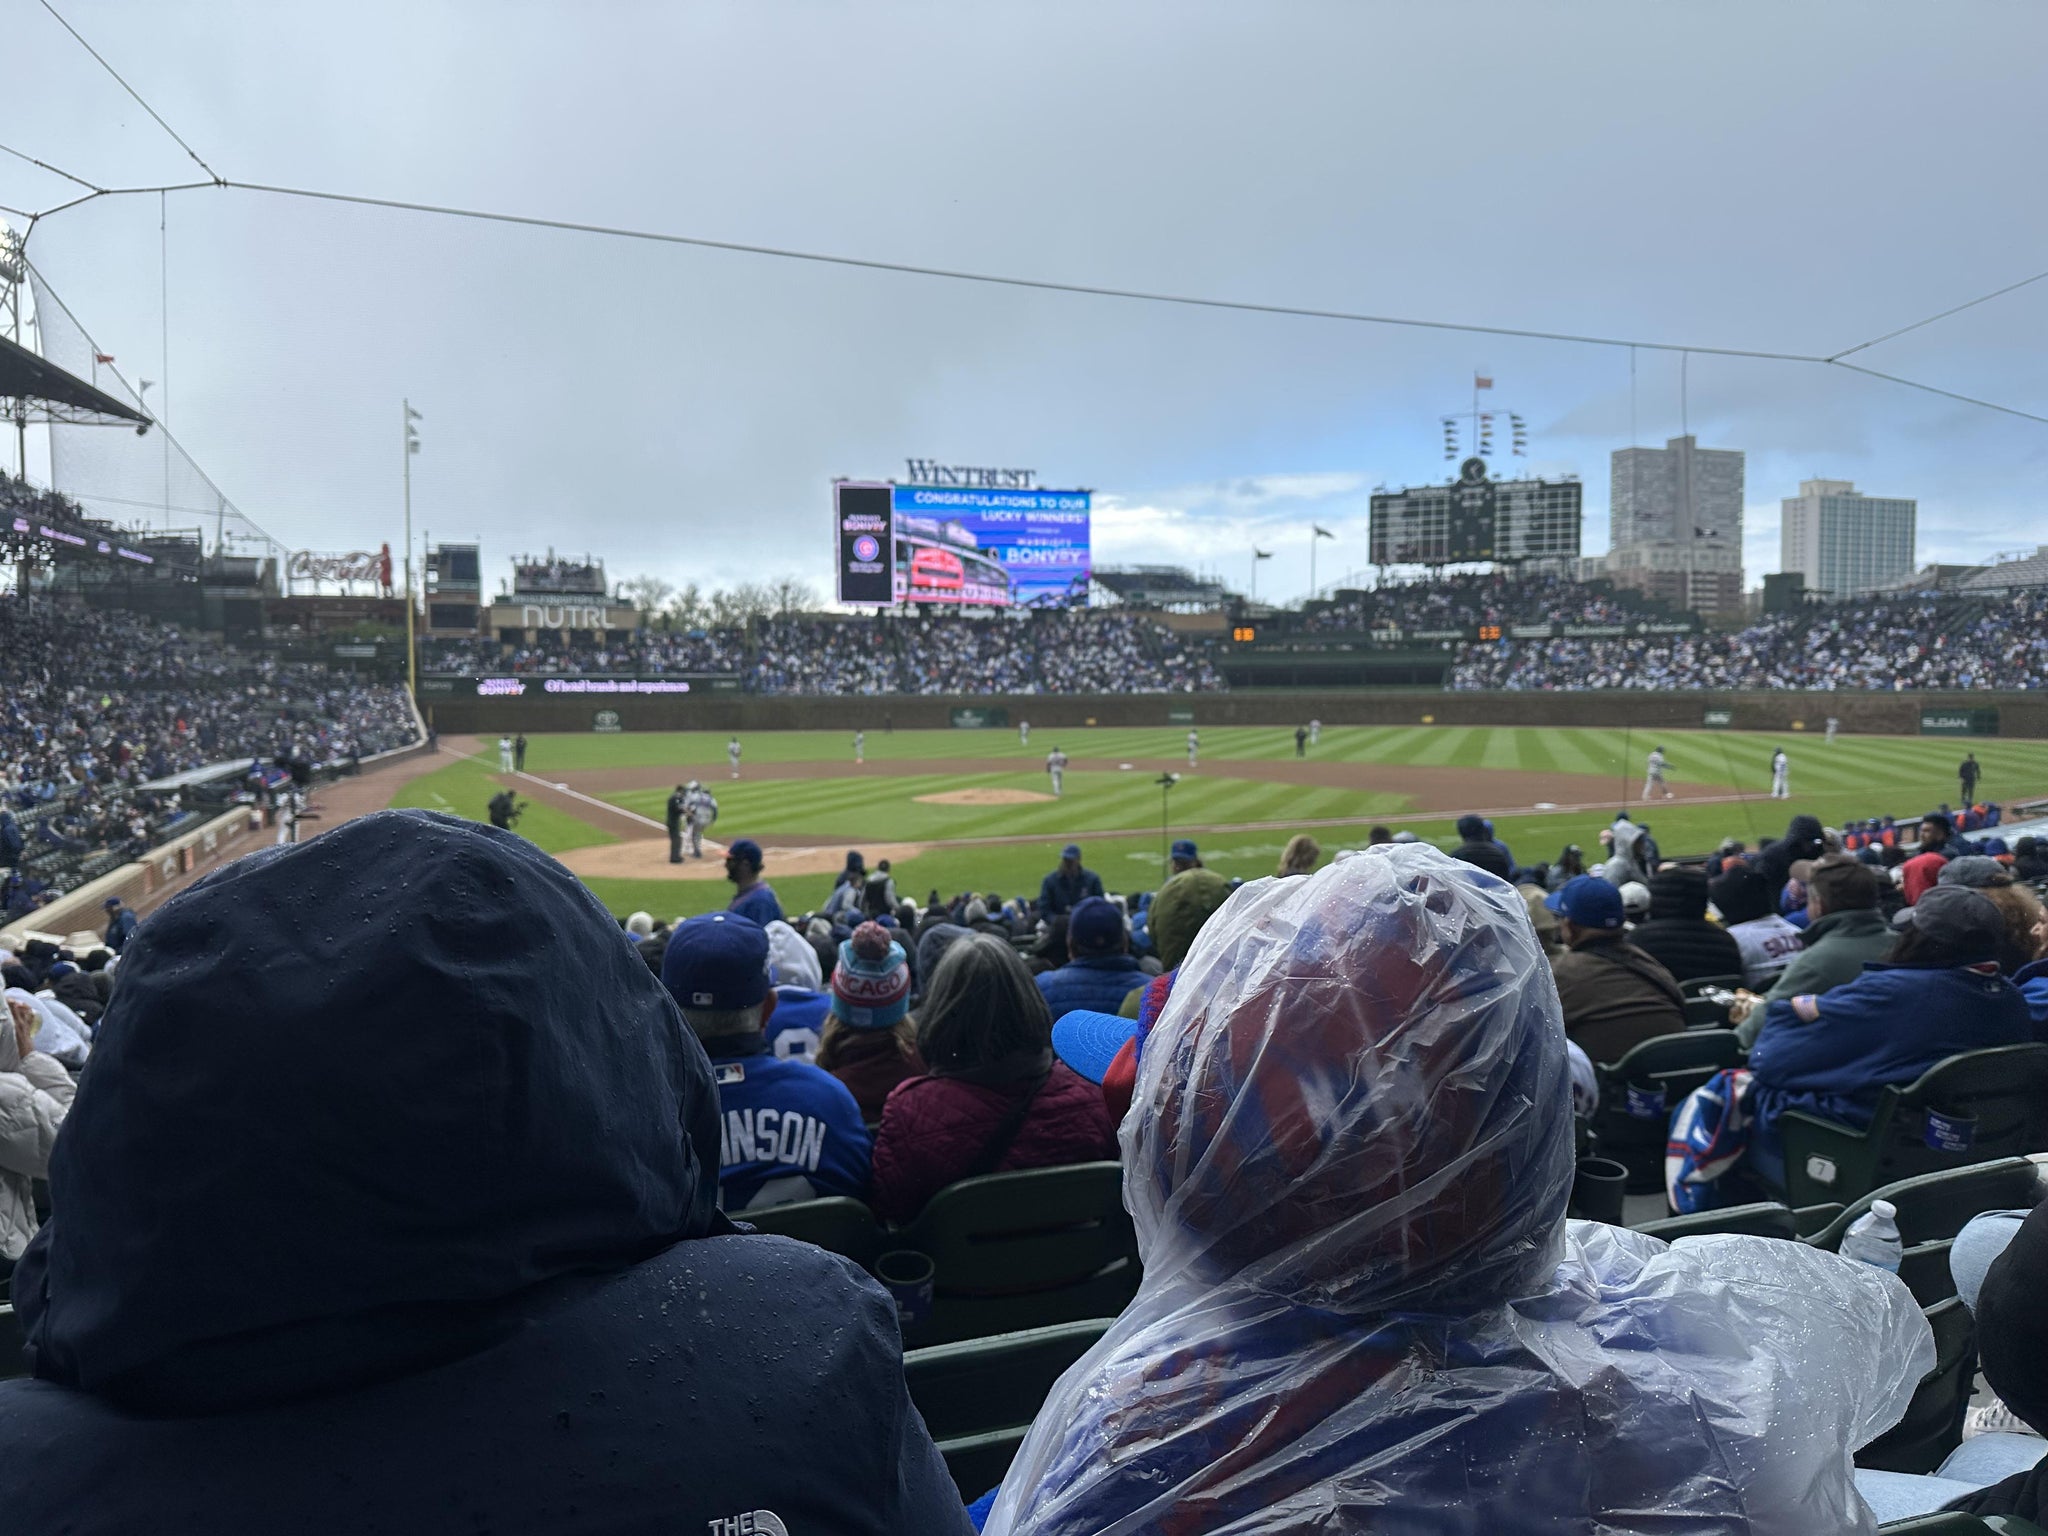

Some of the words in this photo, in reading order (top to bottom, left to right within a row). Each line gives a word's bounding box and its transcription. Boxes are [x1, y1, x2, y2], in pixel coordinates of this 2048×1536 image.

[905, 459, 1036, 488] WINTRUST
[914, 491, 1037, 508] CONGRATULATIONS
[1040, 498, 1057, 508] TO
[1059, 498, 1086, 510] OUR
[981, 510, 1022, 522] LUCKY
[1817, 1161, 1826, 1176] 7
[708, 1511, 753, 1536] THE
